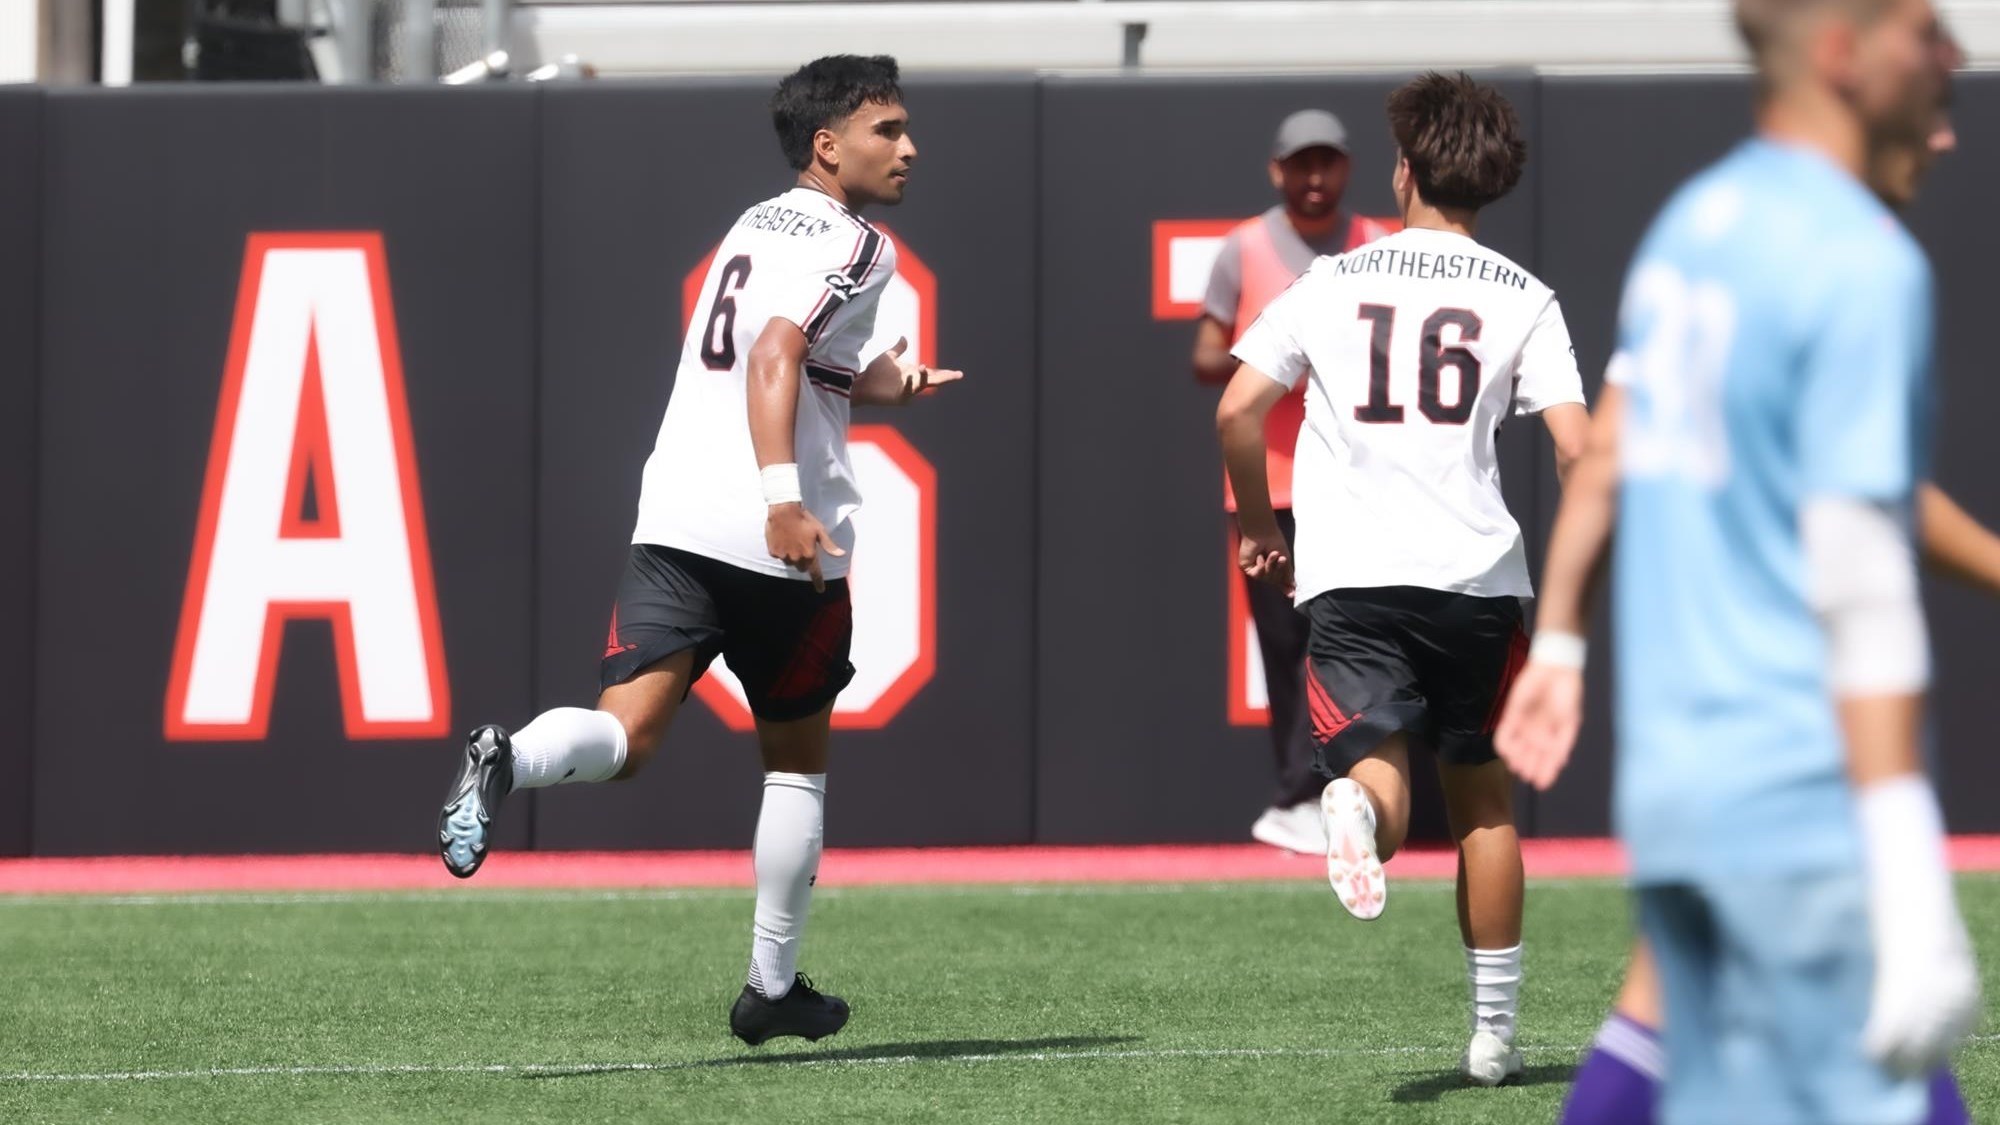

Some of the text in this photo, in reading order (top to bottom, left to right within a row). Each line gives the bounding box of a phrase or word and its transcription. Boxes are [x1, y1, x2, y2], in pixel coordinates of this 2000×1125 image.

[701, 254, 752, 371] 6
[1334, 249, 1528, 290] NORTHEASTERN
[1354, 303, 1483, 425] 16
